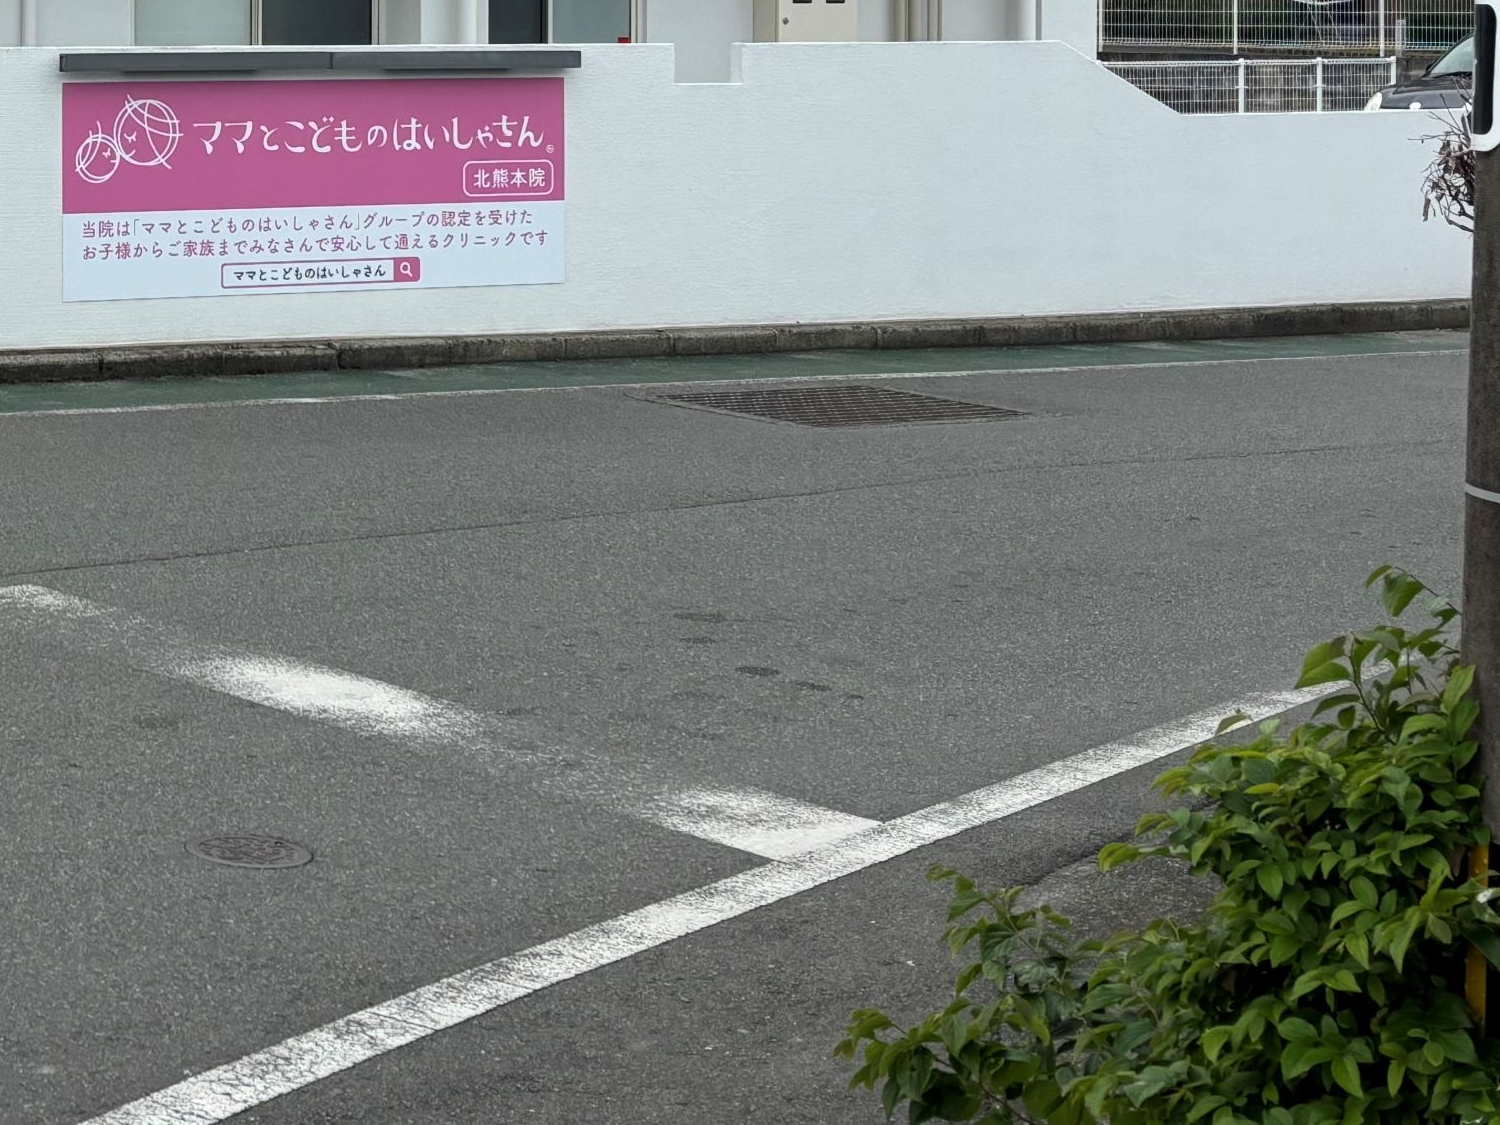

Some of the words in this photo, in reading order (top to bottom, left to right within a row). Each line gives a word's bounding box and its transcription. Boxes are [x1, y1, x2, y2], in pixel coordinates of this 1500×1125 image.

[192, 114, 545, 155] ママとこどものはいしゃさん
[472, 168, 546, 189] 北熊本院
[82, 209, 533, 239] 当院は「ママとこどものはいしゃさん」グループの認定を受けた
[82, 230, 548, 261] お子様からご家族までみなさんで安心して通えるクリニックです
[233, 263, 386, 282] ママとこどものはいしゃさん
